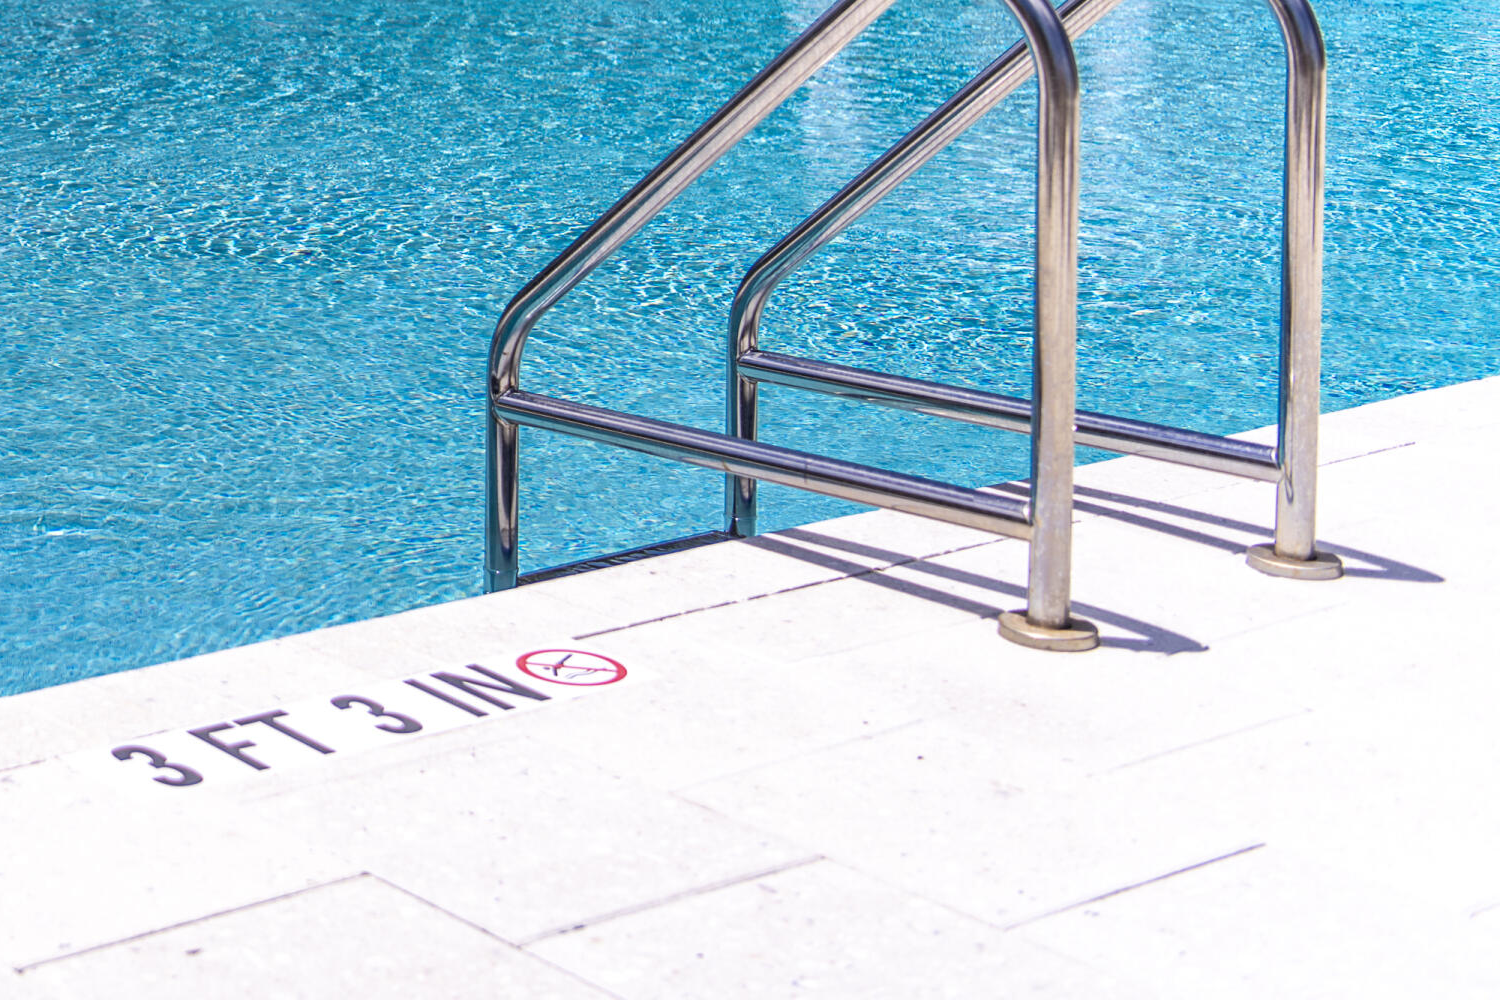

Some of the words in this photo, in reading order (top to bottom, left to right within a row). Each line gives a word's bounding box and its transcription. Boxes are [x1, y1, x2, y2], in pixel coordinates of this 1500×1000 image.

[111, 745, 203, 786] 3
[187, 709, 336, 770] FT
[330, 695, 423, 733] 3
[403, 664, 552, 717] IN
